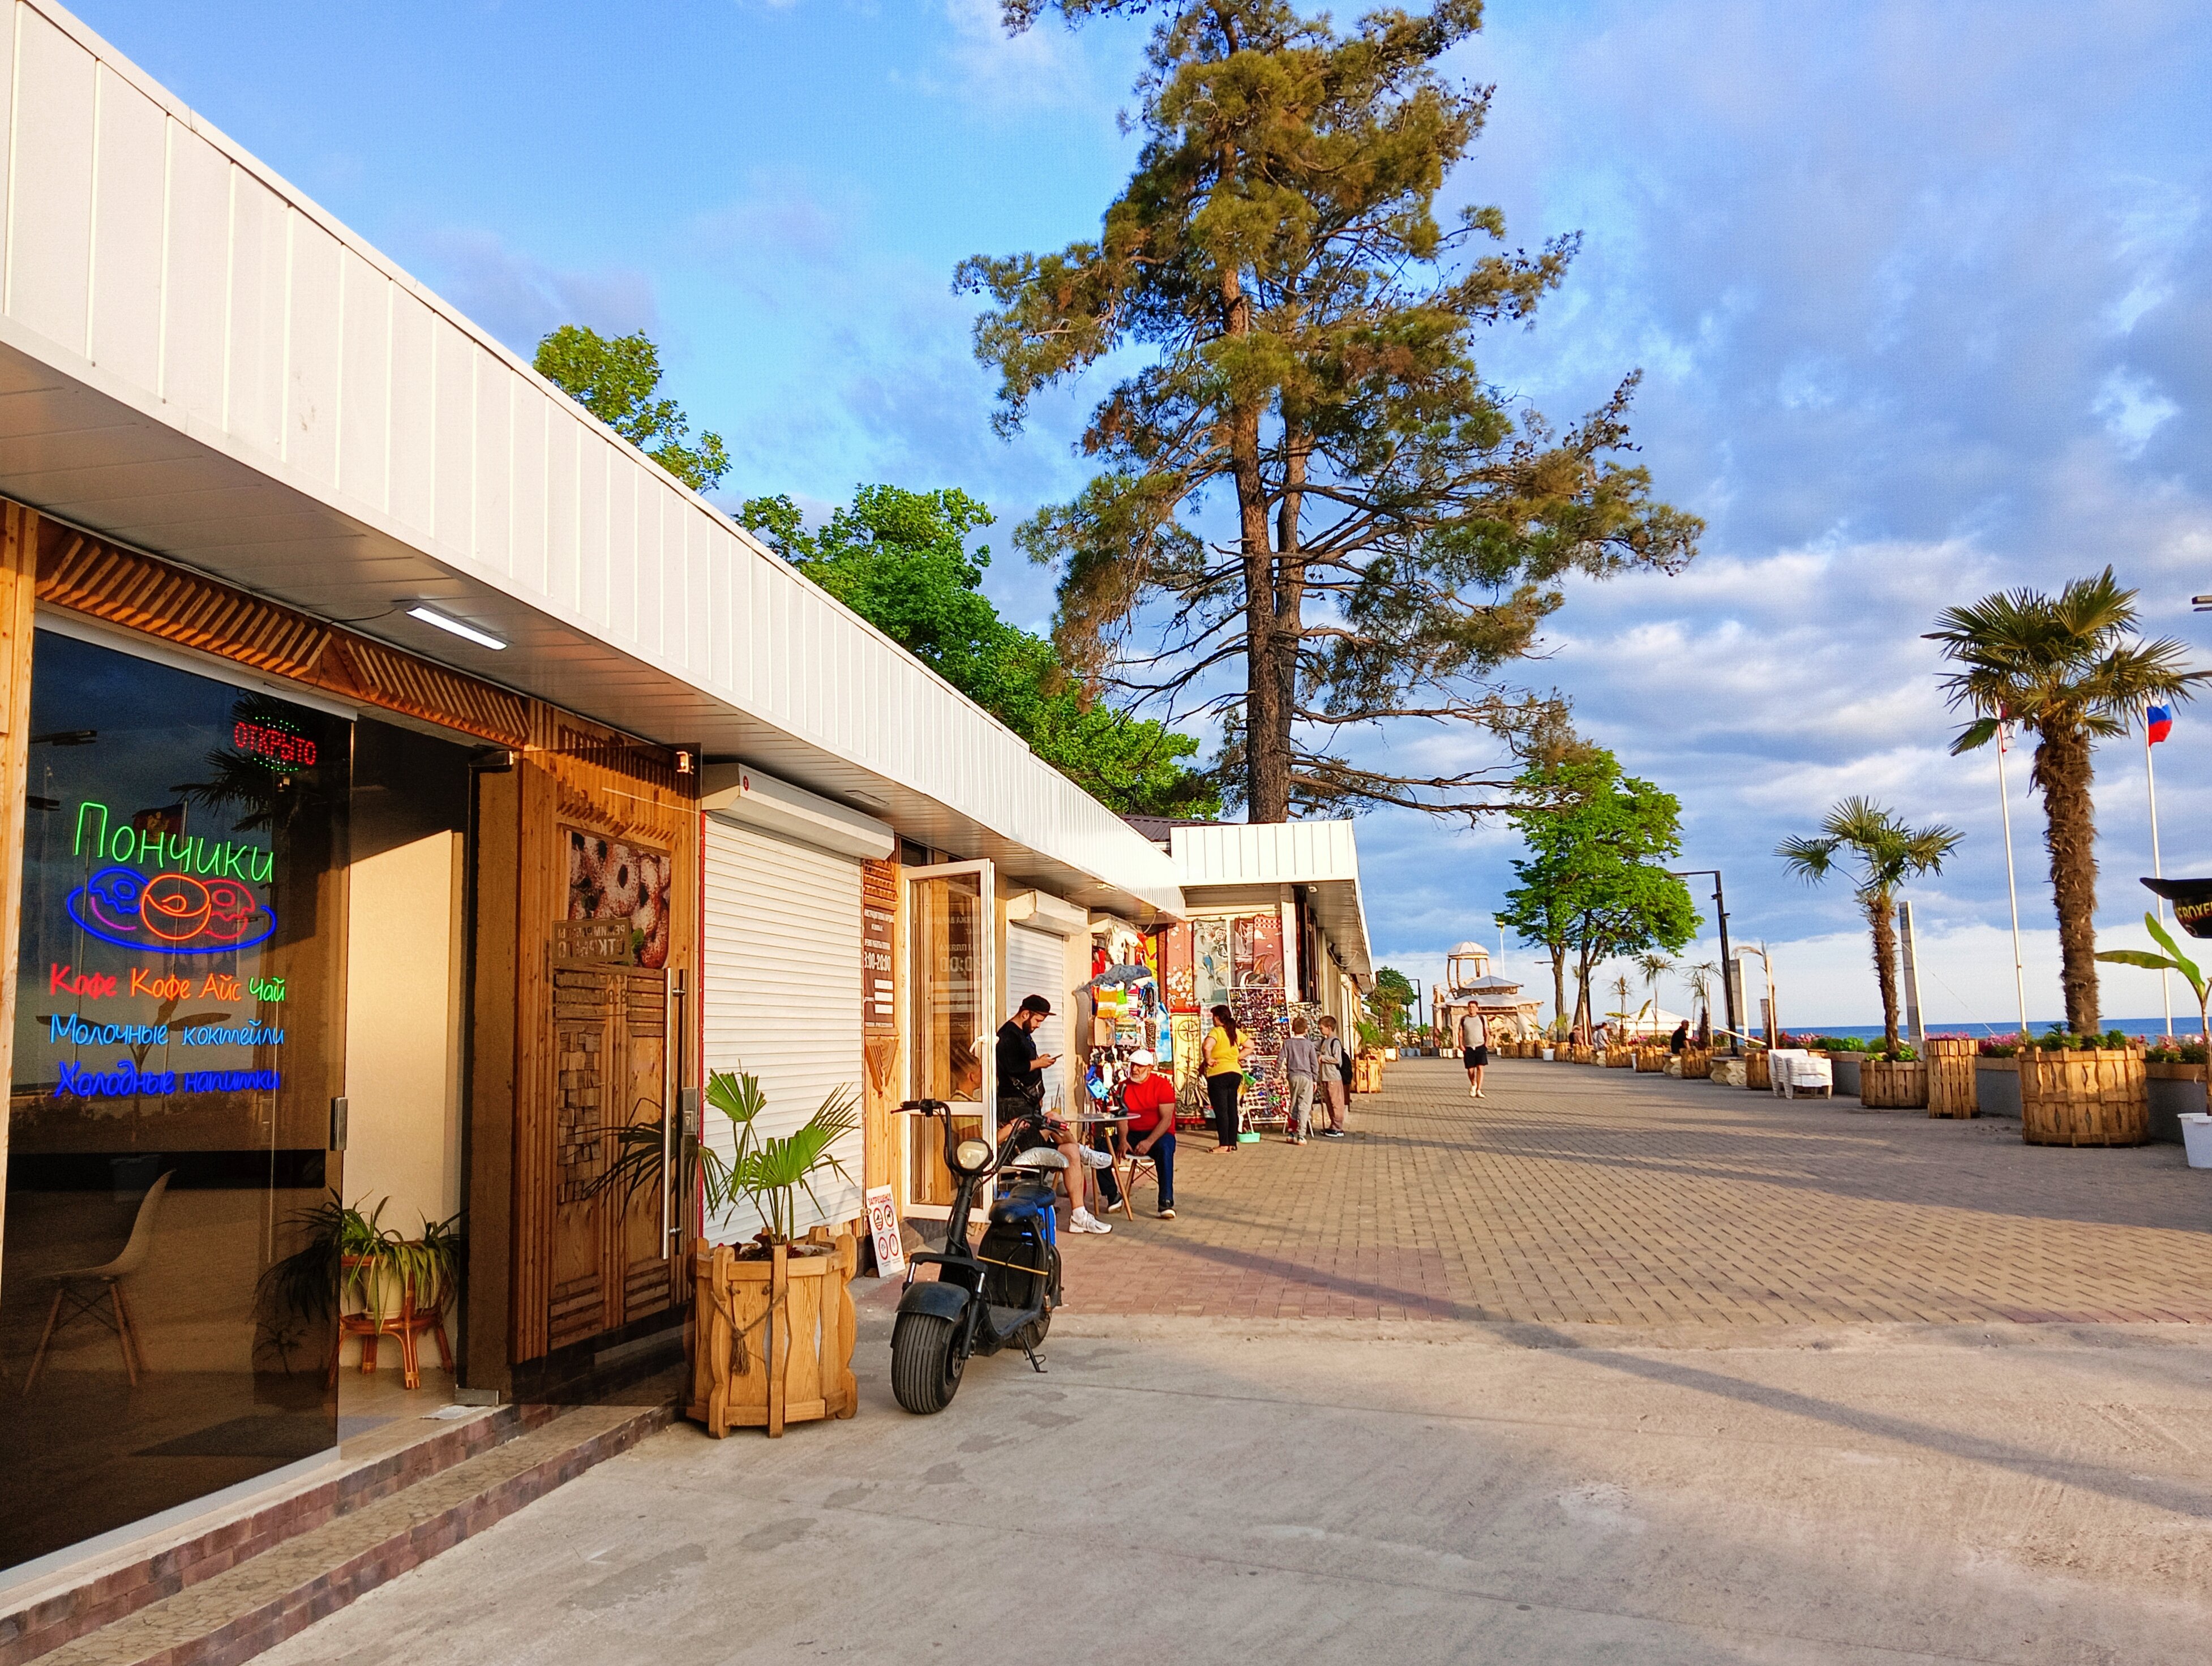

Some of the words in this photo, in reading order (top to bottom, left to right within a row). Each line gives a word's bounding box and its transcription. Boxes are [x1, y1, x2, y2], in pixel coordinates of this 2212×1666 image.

[234, 721, 316, 765] ОТКРЫТО
[73, 802, 274, 883] Пончики
[50, 963, 117, 1000] Кофе
[130, 967, 191, 1001] Кофе
[198, 973, 242, 1001] Айс
[249, 977, 285, 1002] Чай
[50, 1012, 170, 1045] Молочные
[181, 1018, 285, 1046] коктейли
[54, 1059, 176, 1098] Холодные
[184, 1069, 281, 1094] напитки
